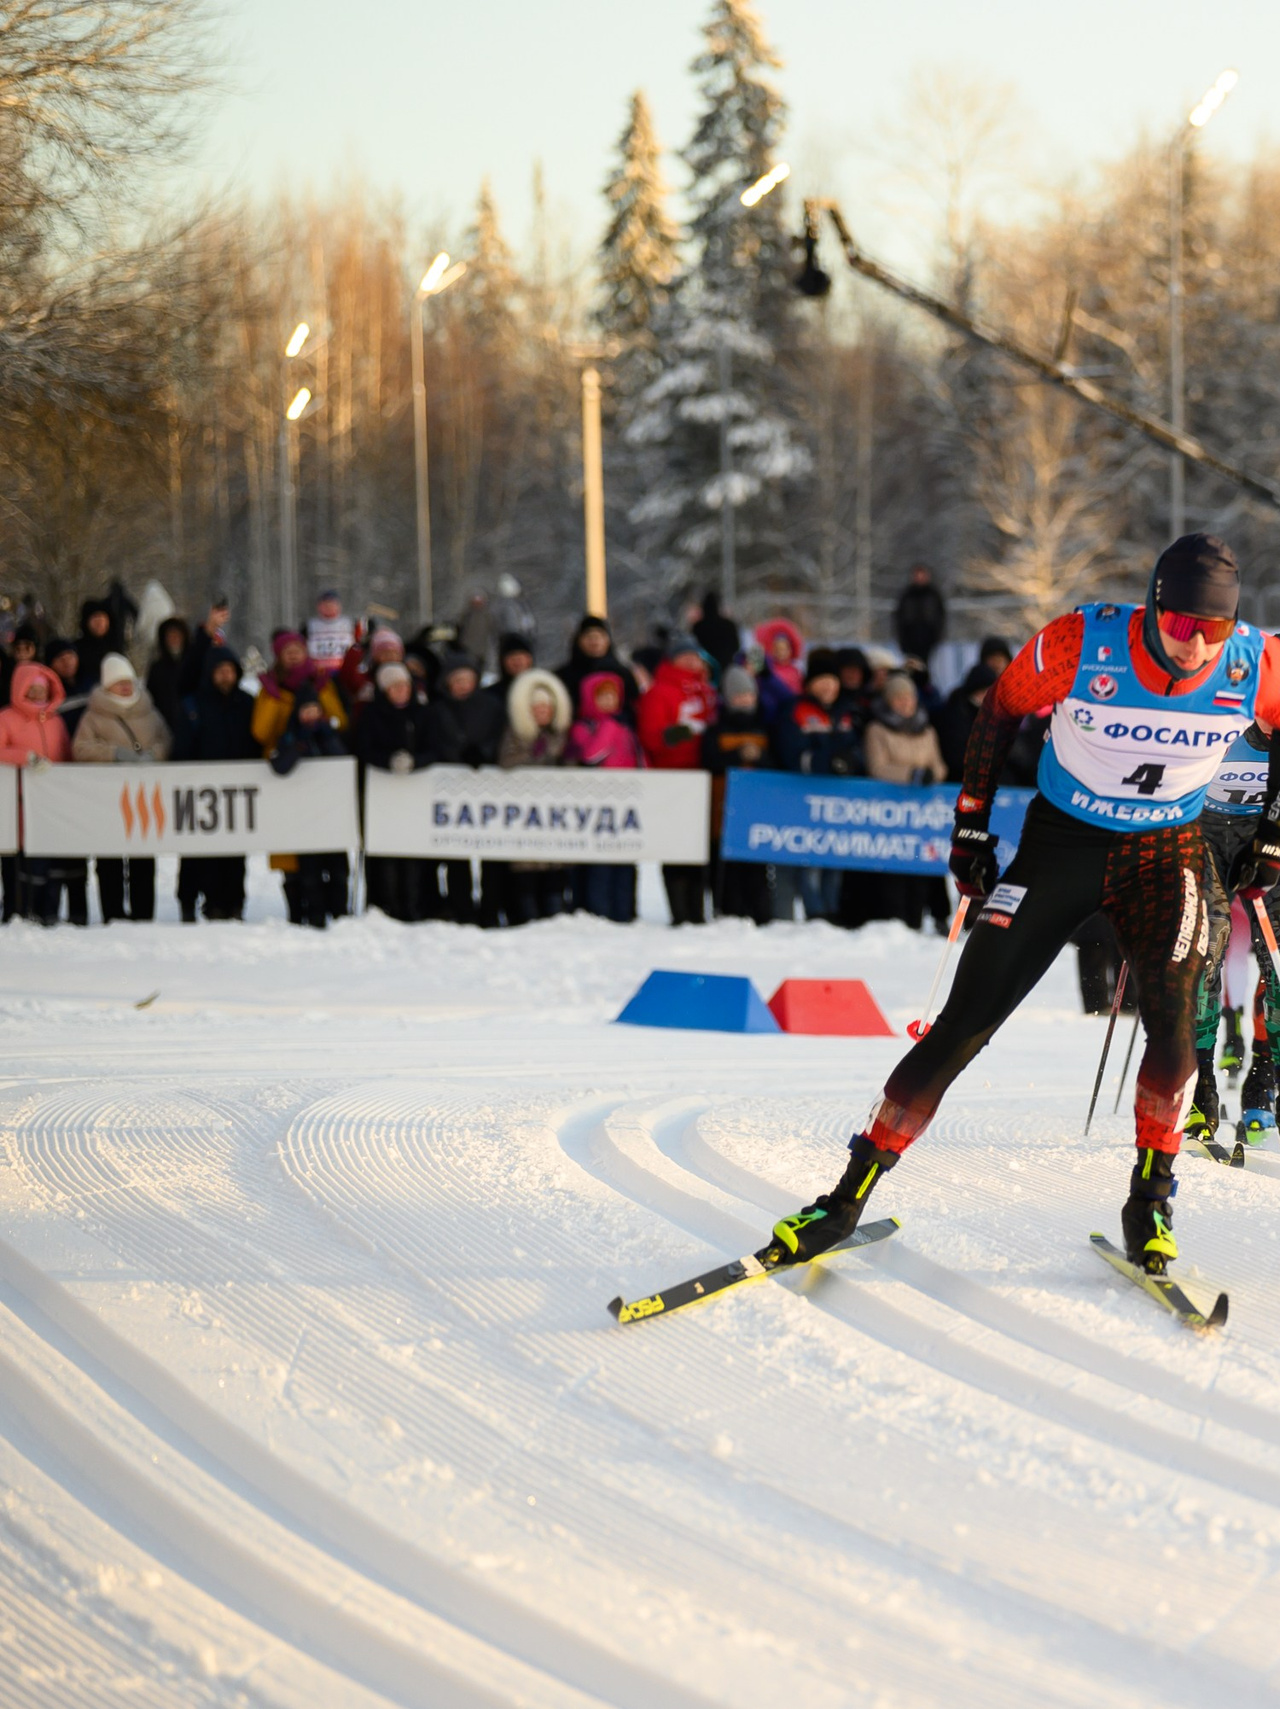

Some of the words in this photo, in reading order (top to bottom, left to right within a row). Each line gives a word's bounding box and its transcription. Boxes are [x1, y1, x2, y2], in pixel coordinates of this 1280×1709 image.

[1103, 722, 1241, 748] ФОСАГРО
[1121, 763, 1167, 796] 4
[173, 787, 260, 833] ИЗТТ
[432, 802, 642, 835] БАРРАКУДА
[748, 823, 922, 862] РУСКЛИМАТ
